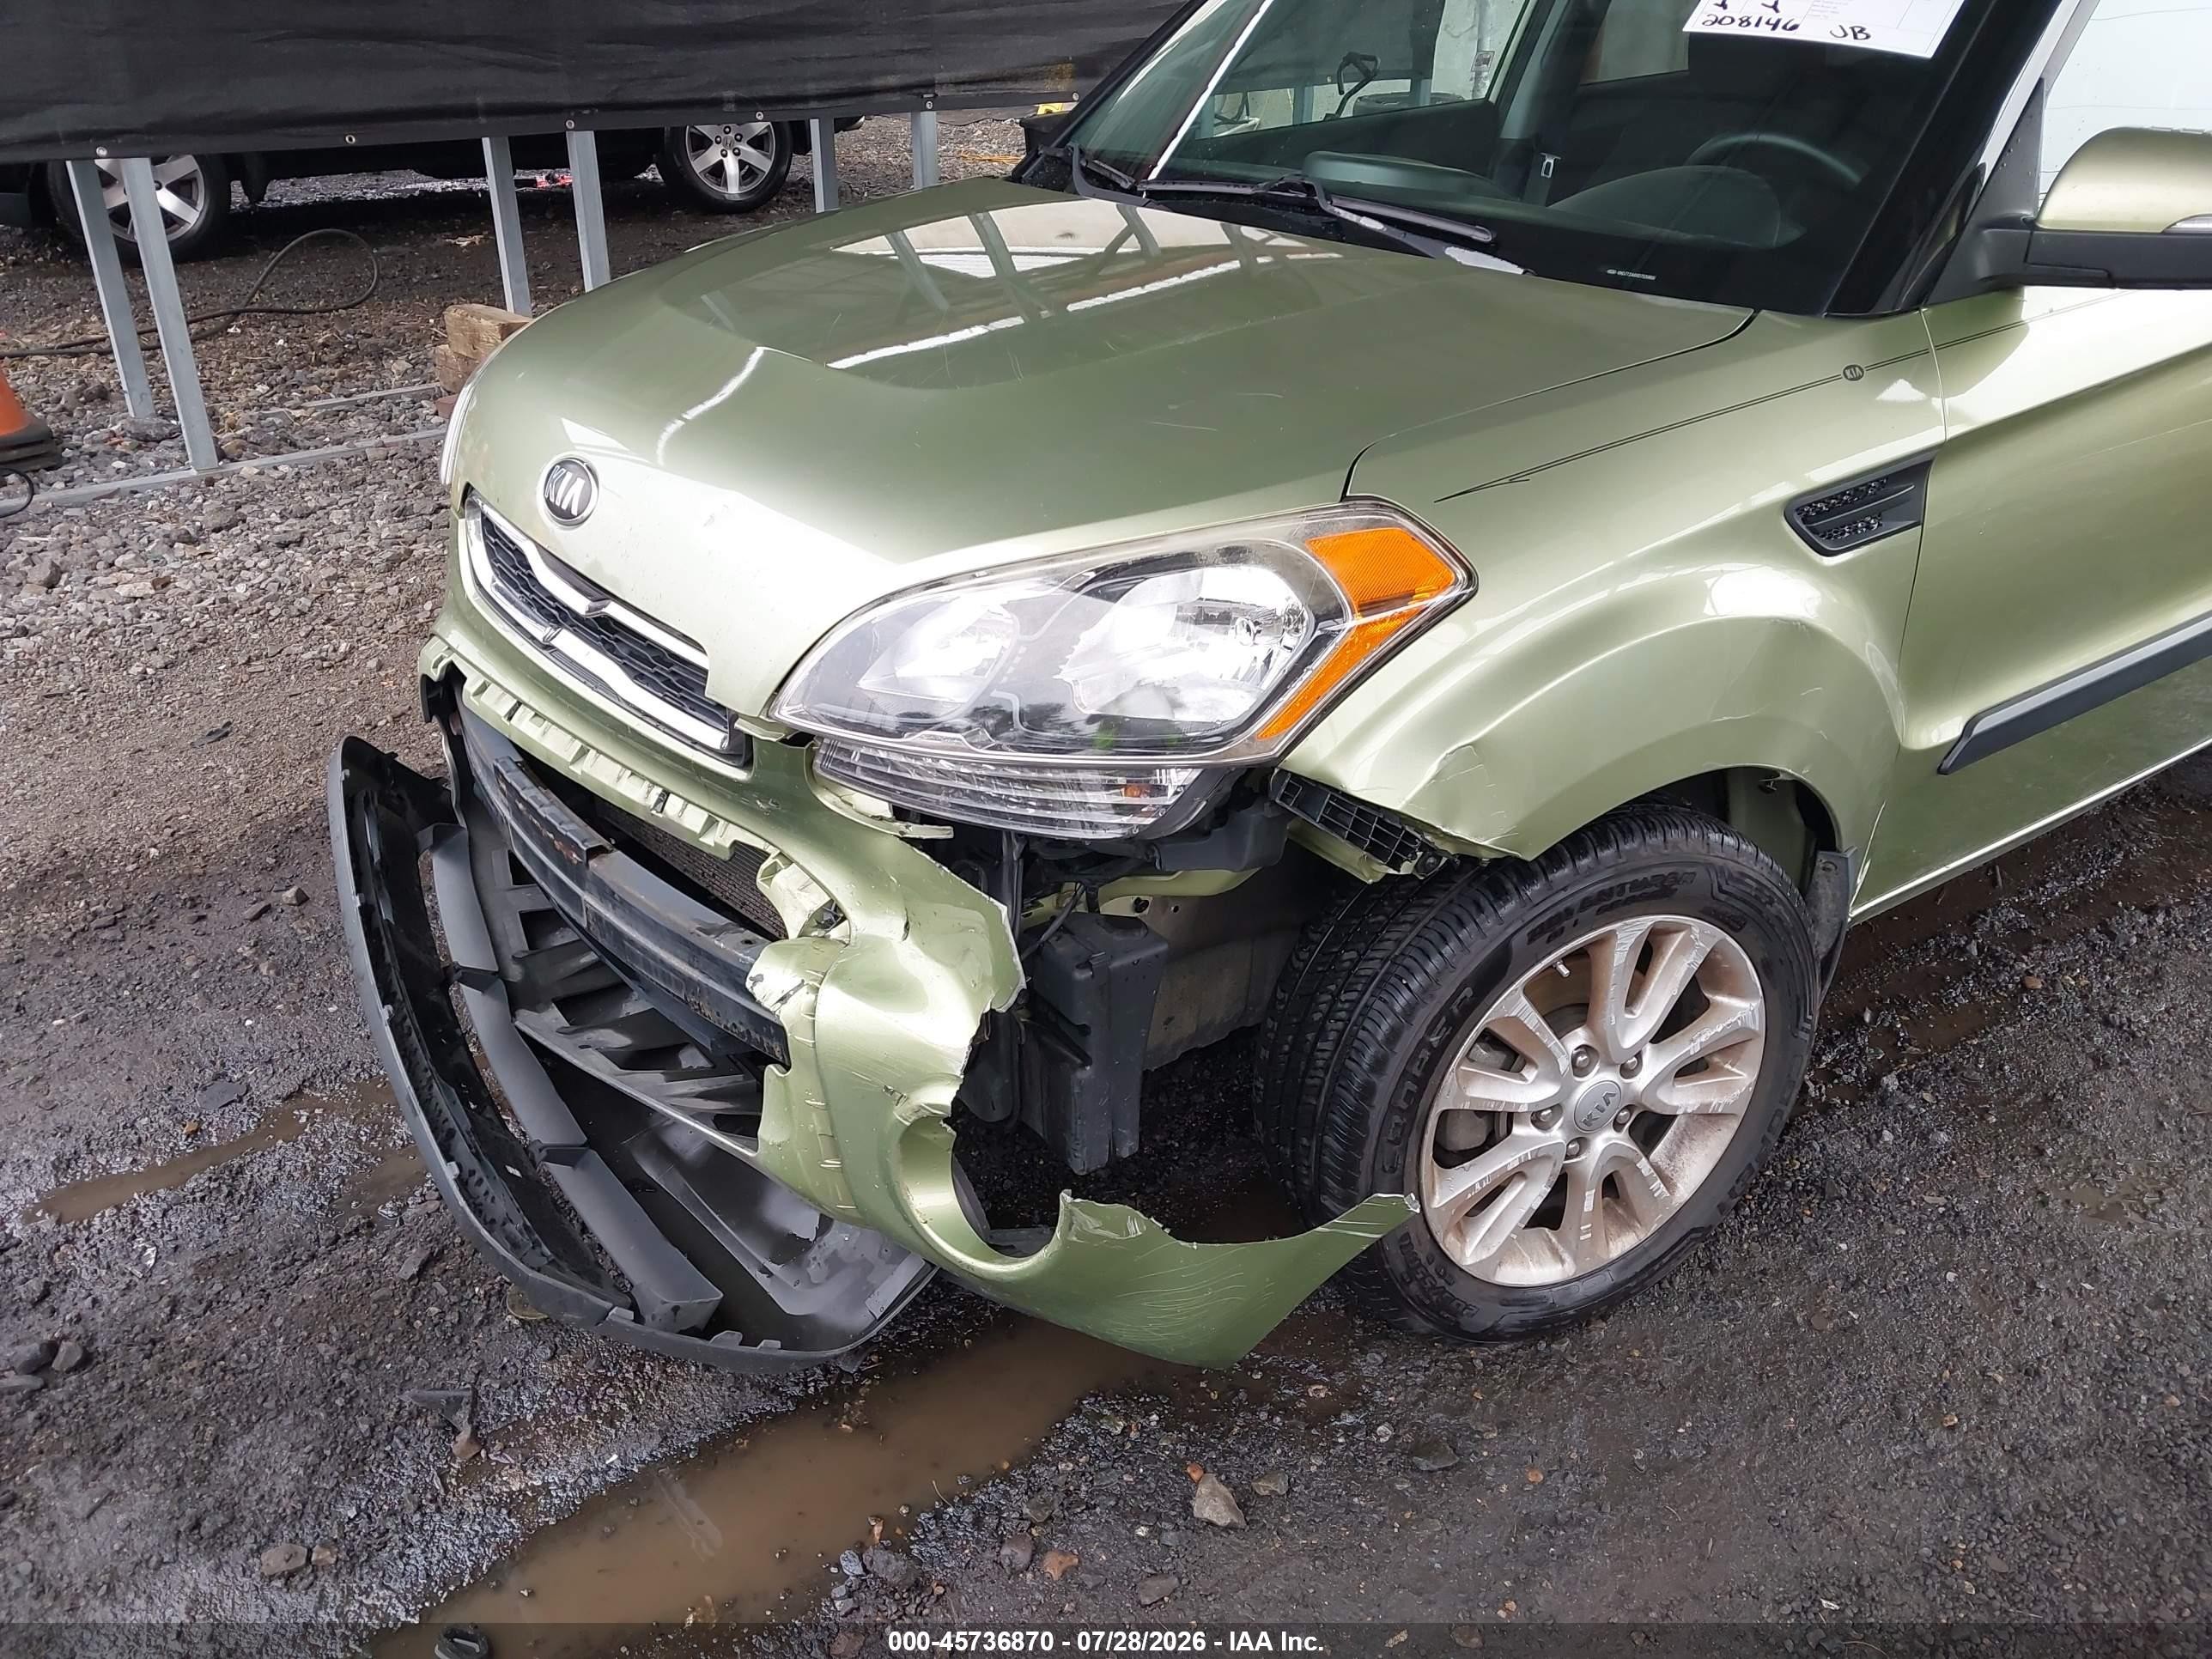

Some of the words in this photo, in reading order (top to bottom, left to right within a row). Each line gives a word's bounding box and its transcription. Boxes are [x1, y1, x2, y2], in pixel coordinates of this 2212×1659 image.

[1702, 13, 1801, 31] 208146
[1830, 24, 1871, 40] JB
[544, 465, 586, 516] KIA
[1581, 1091, 1617, 1127] KIA
